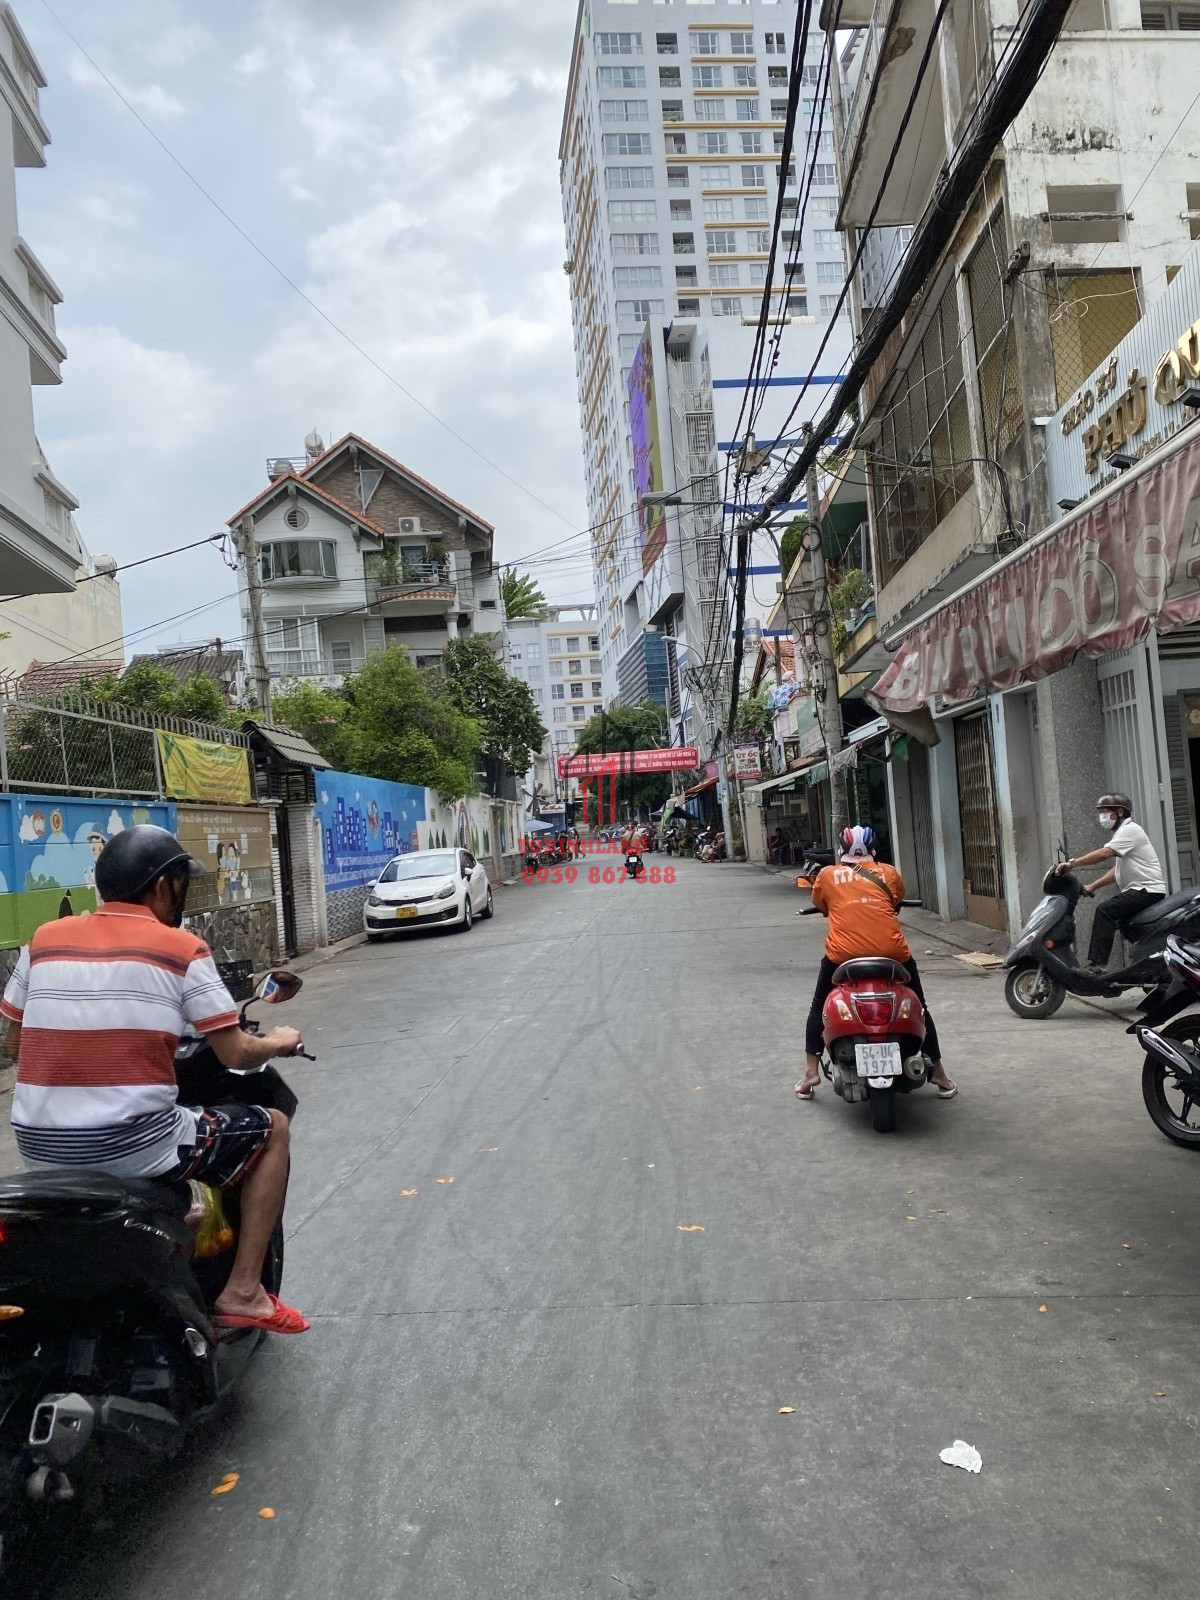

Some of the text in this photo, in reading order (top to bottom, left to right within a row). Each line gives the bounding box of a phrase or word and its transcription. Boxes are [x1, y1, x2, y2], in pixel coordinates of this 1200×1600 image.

[1061, 391, 1095, 436] GIÁO
[1082, 368, 1147, 475] PHÚ
[862, 1045, 893, 1060] 54-U4
[863, 1060, 894, 1074] 1971
